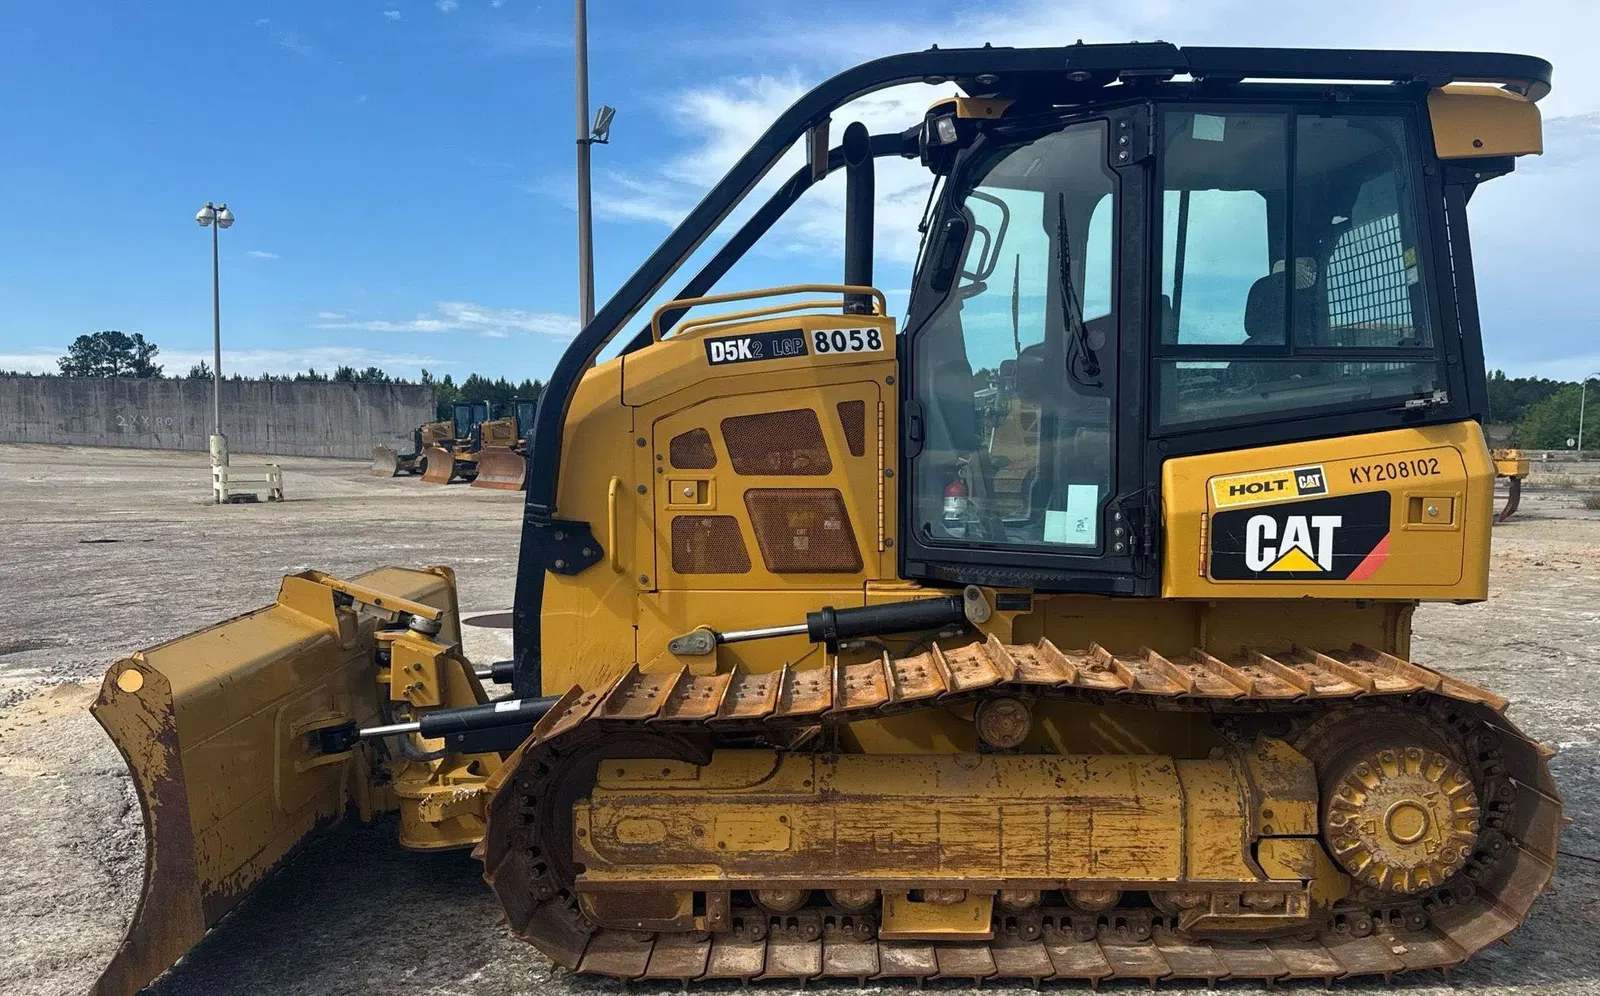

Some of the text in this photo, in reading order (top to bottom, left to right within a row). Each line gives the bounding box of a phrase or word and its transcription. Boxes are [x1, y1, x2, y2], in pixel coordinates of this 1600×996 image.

[772, 338, 804, 356] LGP
[815, 329, 882, 353] 8058
[1349, 458, 1441, 484] KY208102
[1229, 474, 1321, 496] HOLT CAT
[1245, 514, 1343, 572] CAT
